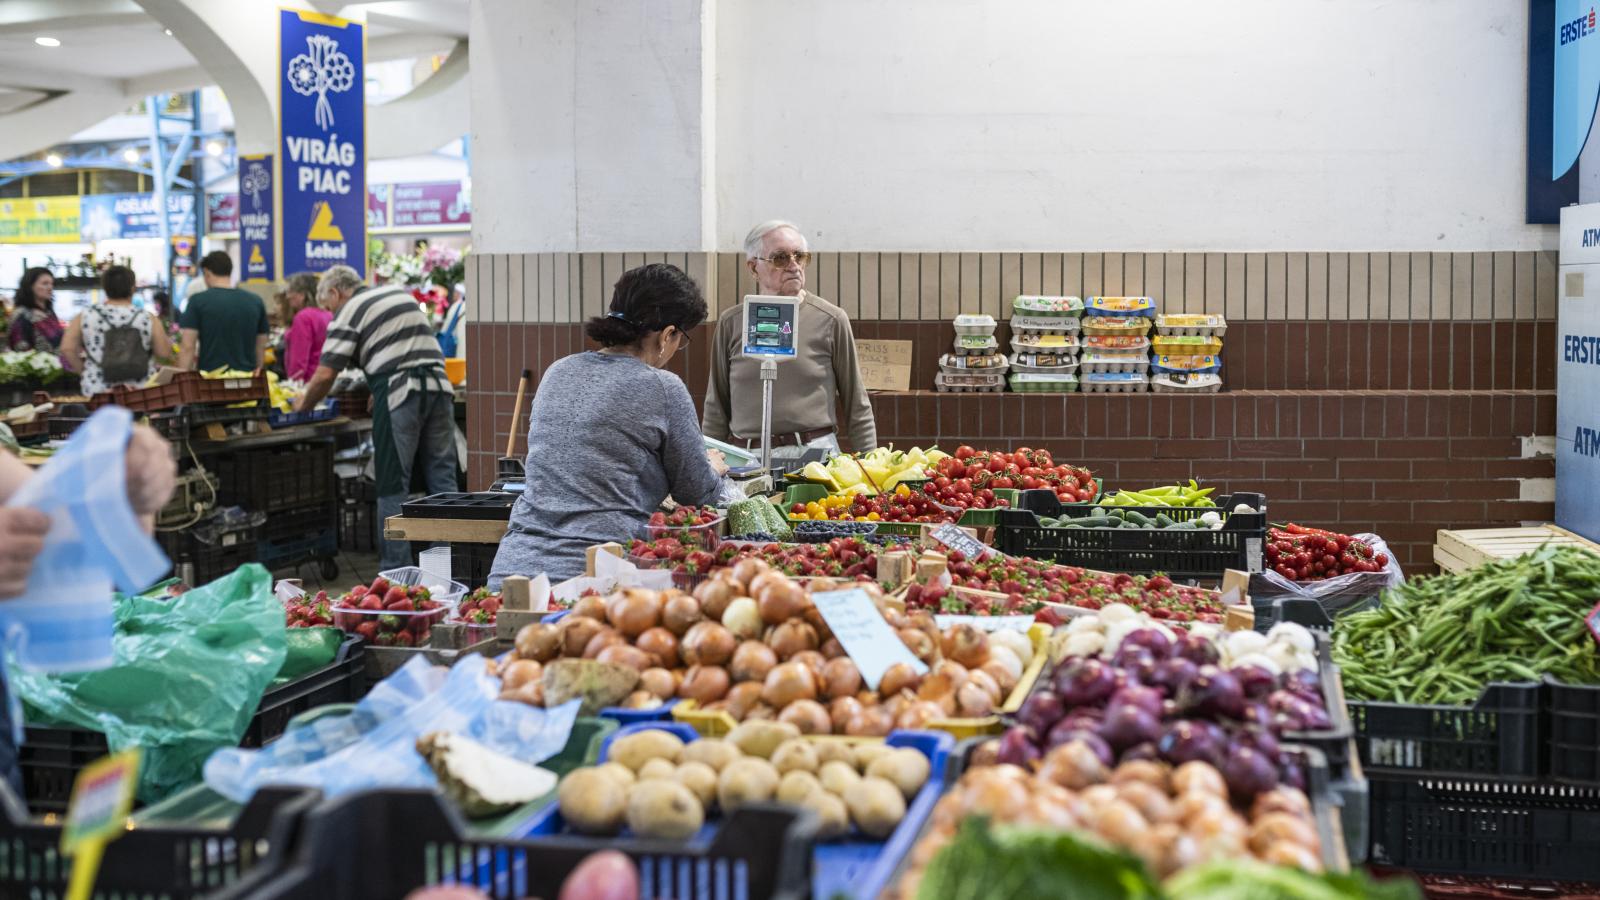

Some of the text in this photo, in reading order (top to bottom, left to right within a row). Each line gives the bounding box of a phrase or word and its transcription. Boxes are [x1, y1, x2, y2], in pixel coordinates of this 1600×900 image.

[1561, 15, 1587, 46] ERSTE
[286, 133, 356, 167] VIRÁG
[298, 166, 351, 194] PIAC
[245, 227, 267, 240] PIAC
[305, 241, 347, 260] Lehel
[1574, 426, 1600, 459] ATM
